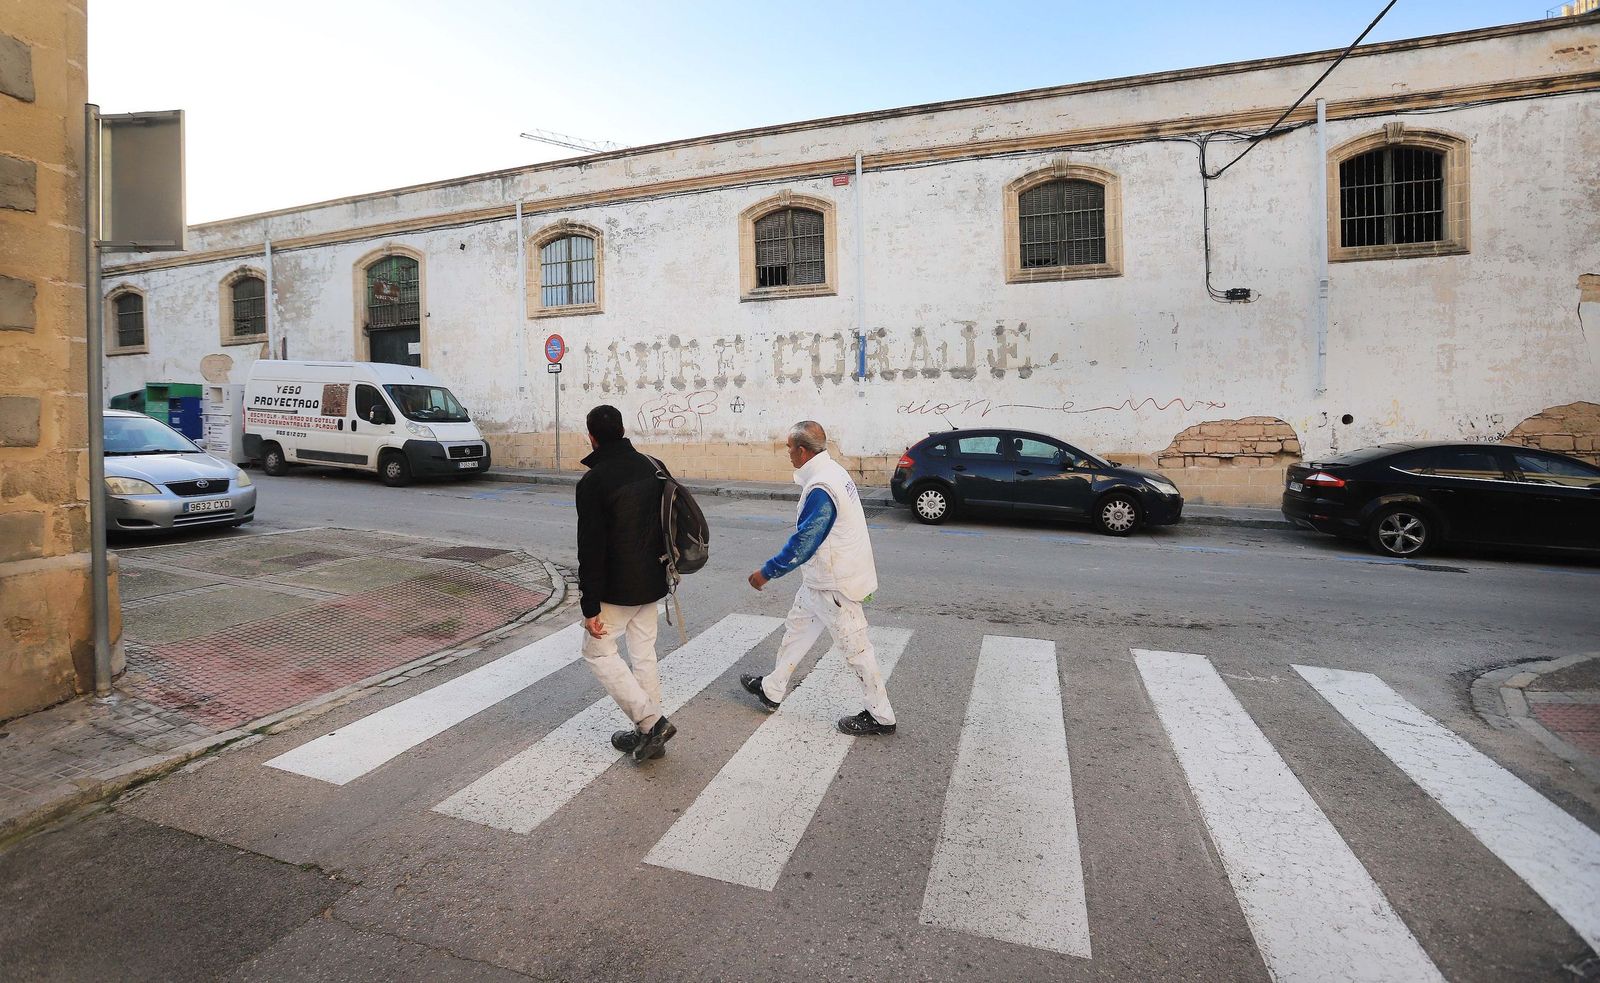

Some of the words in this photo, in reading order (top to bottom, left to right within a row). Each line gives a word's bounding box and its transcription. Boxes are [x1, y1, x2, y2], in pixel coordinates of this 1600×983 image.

[276, 385, 302, 394] YESO
[254, 396, 319, 409] PROYECTADO
[190, 502, 212, 511] 9632
[213, 500, 230, 509] CXD
